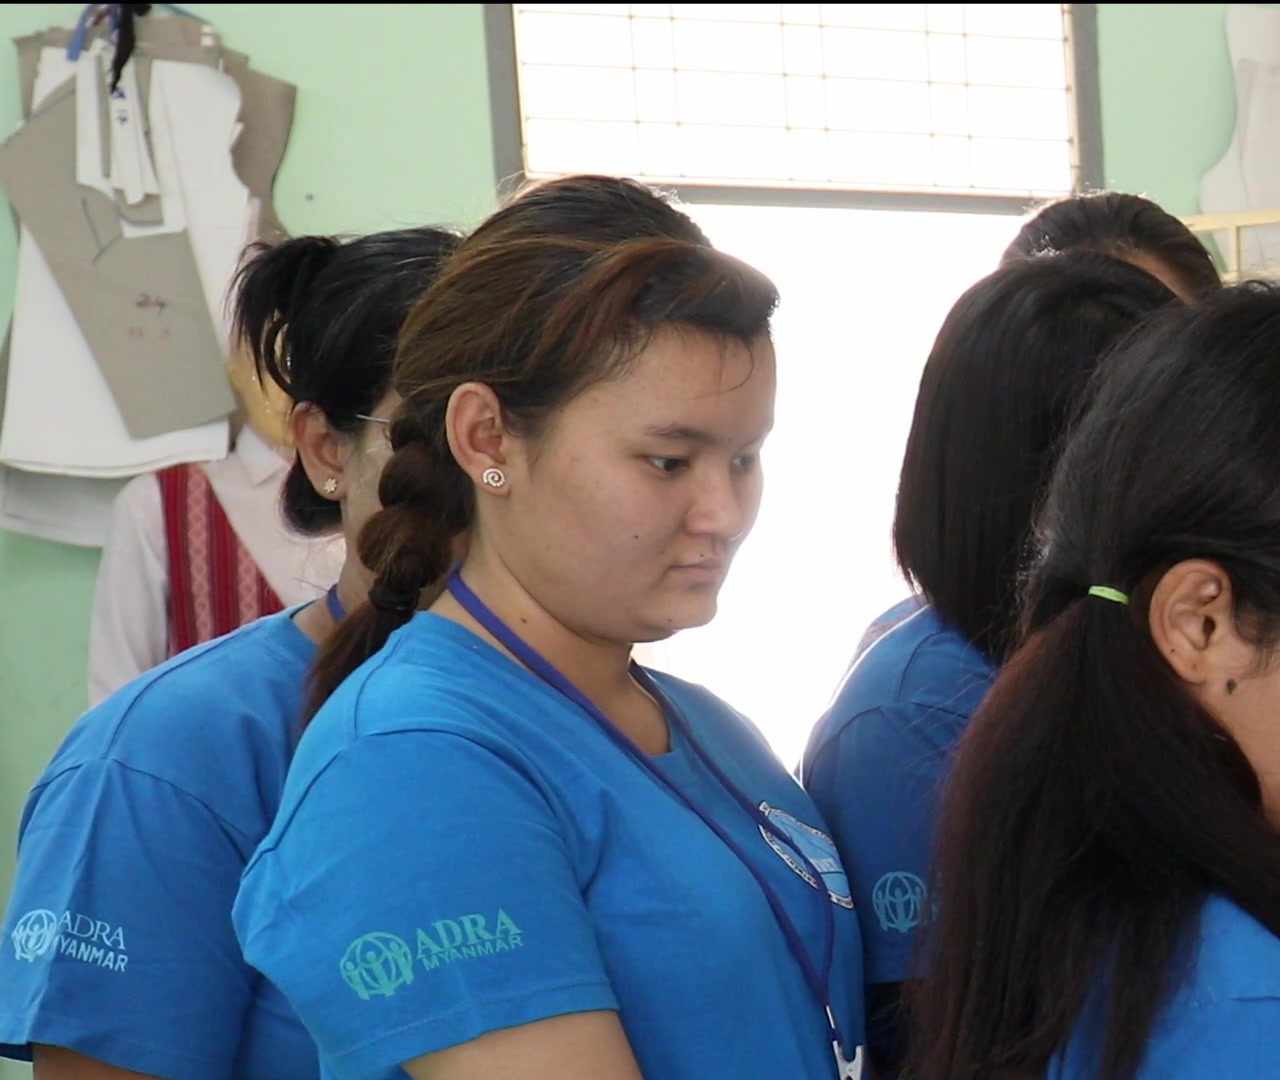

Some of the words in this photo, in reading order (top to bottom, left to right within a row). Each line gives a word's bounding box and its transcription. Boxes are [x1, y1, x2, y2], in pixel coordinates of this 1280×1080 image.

[58, 909, 127, 952] ADRA
[415, 907, 523, 961] ADRA
[421, 933, 524, 972] MYANMAR
